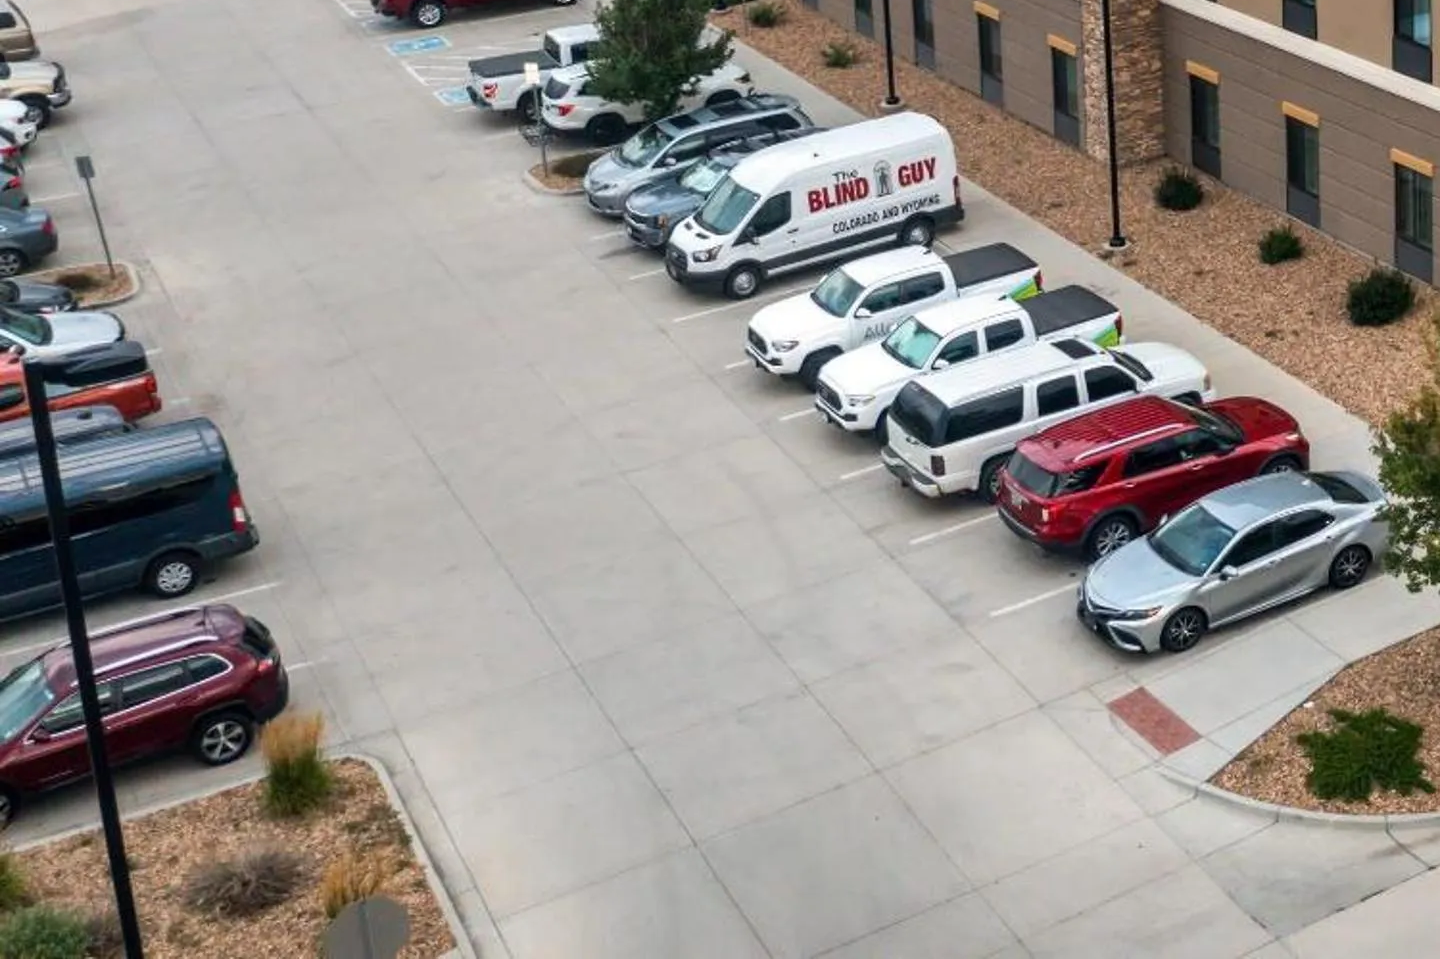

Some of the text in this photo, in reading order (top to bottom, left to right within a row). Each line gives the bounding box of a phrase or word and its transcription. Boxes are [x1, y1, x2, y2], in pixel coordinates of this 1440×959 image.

[807, 156, 936, 213] BLIND GUY
[832, 169, 859, 182] The
[833, 193, 941, 234] COLORADO AND WYOMING
